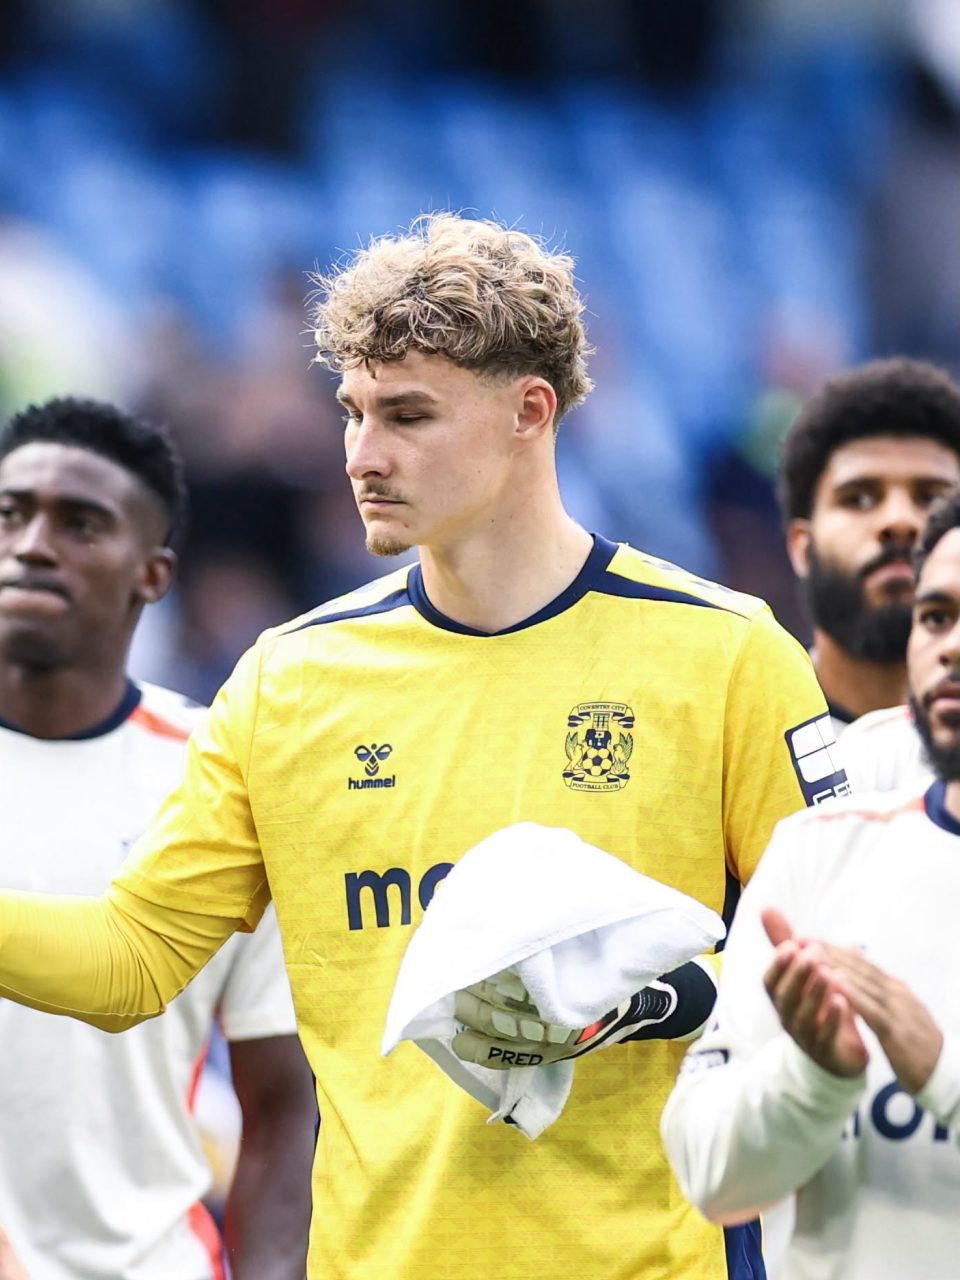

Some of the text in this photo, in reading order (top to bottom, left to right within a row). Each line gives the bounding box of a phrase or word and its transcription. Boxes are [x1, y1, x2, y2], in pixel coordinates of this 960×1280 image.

[611, 704, 625, 712] CITY
[348, 774, 396, 790] hummel
[487, 1046, 544, 1067] PRED
